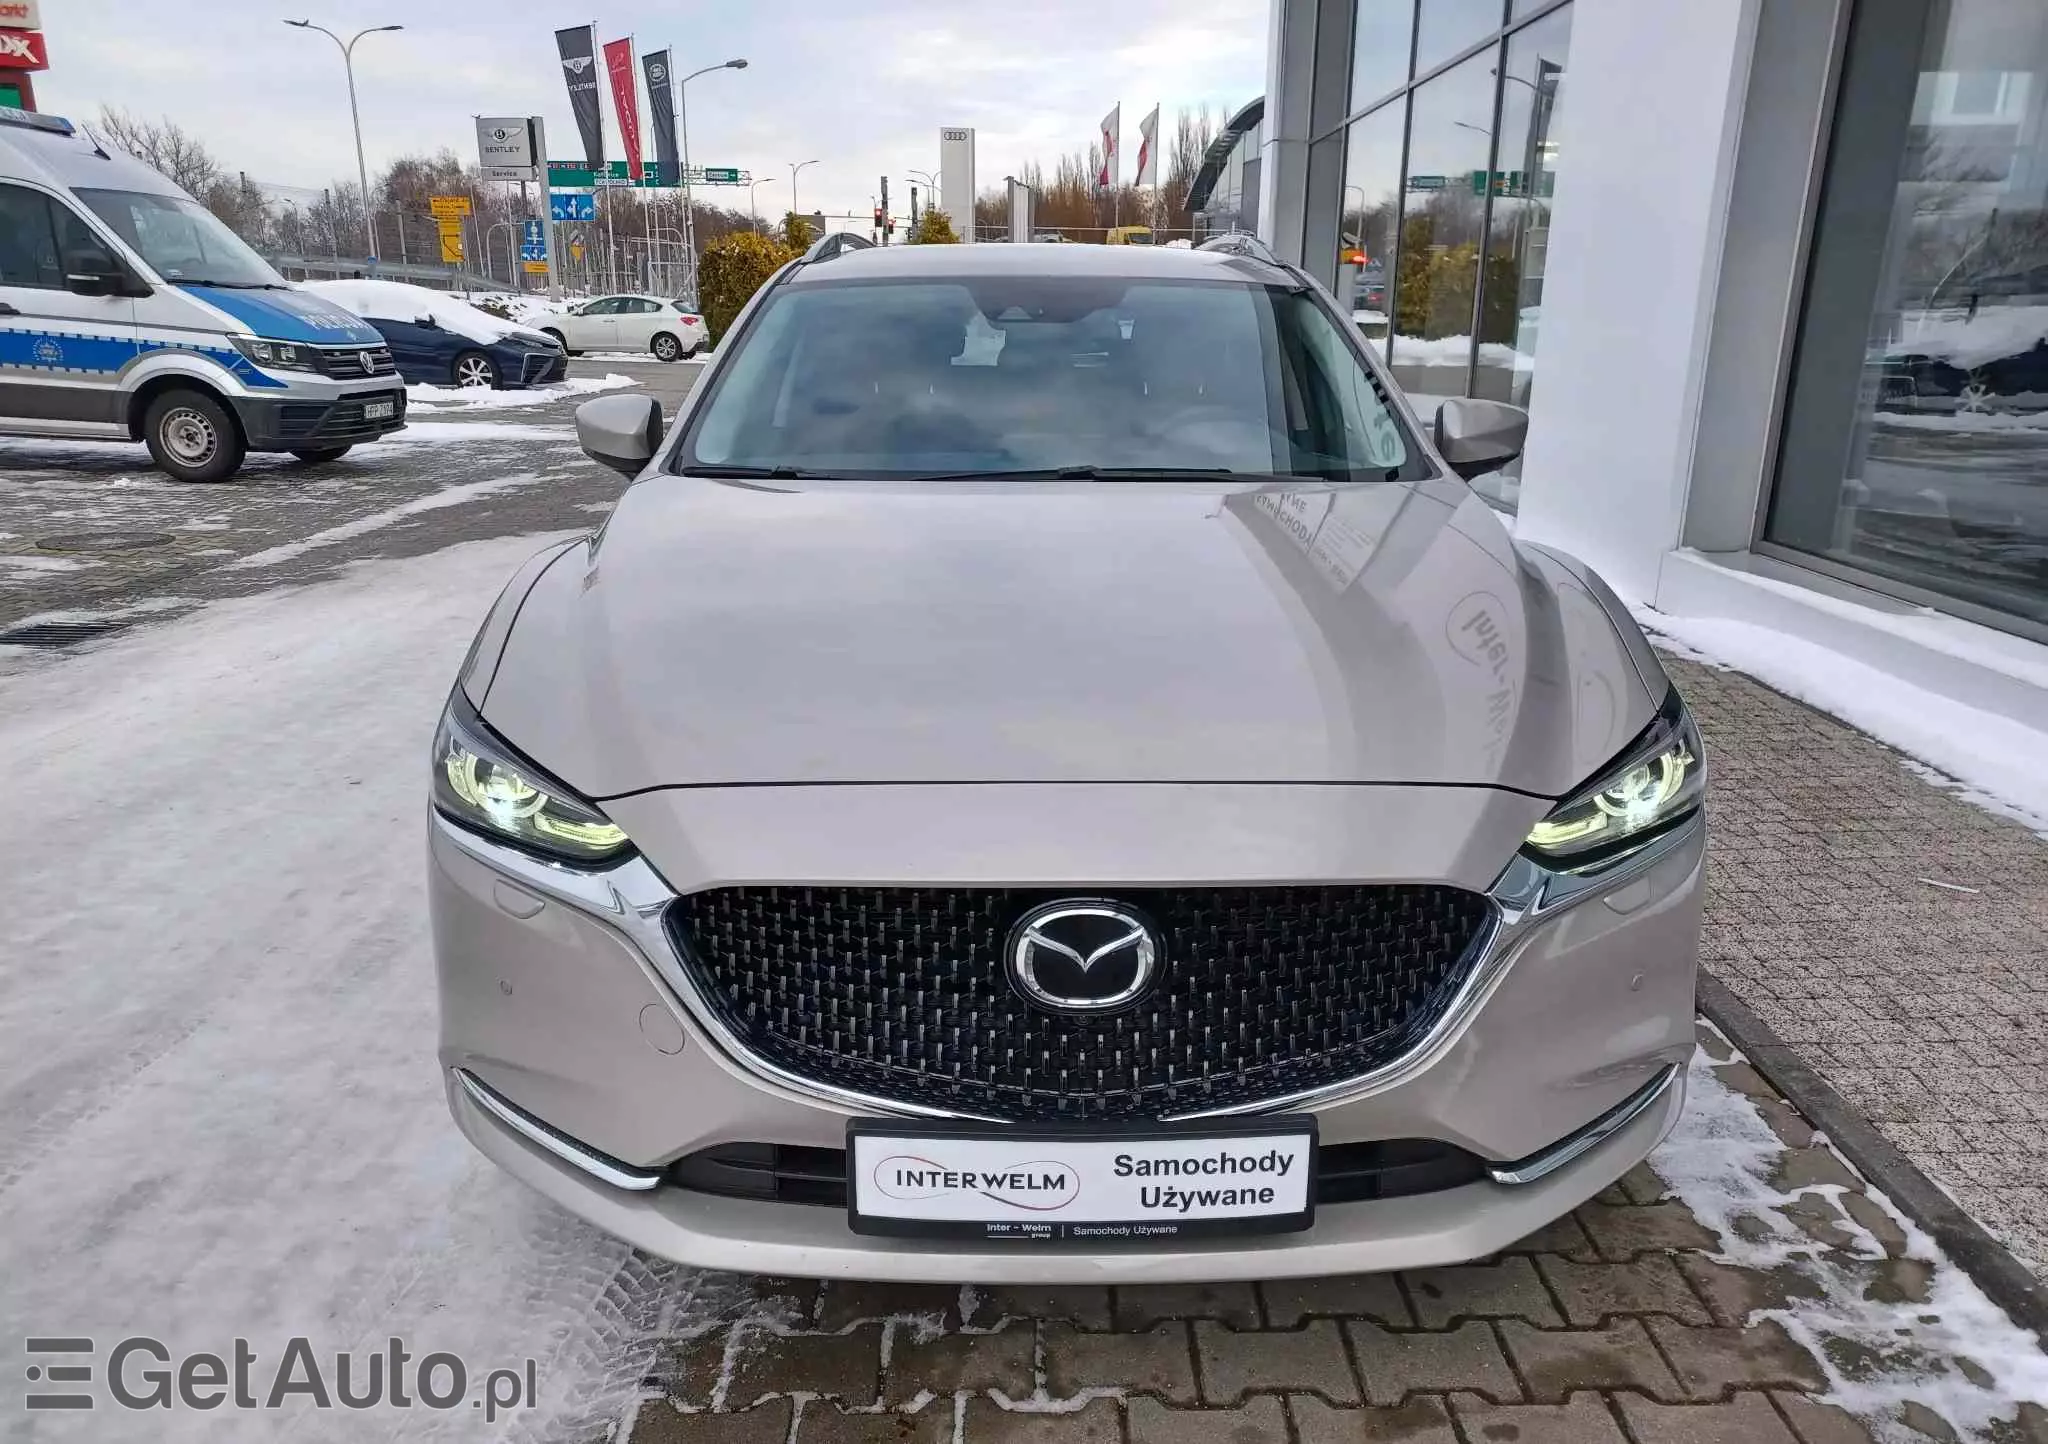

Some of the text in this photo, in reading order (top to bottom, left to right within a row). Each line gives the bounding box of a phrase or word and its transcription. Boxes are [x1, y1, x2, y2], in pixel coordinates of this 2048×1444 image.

[1113, 1150, 1295, 1177] Samochody
[896, 1169, 1065, 1190] INTERWELM
[1140, 1186, 1275, 1213] Używane
[986, 1223, 1011, 1232] Inter
[1021, 1223, 1052, 1232] Welm
[1073, 1225, 1178, 1236] Samochody Używane
